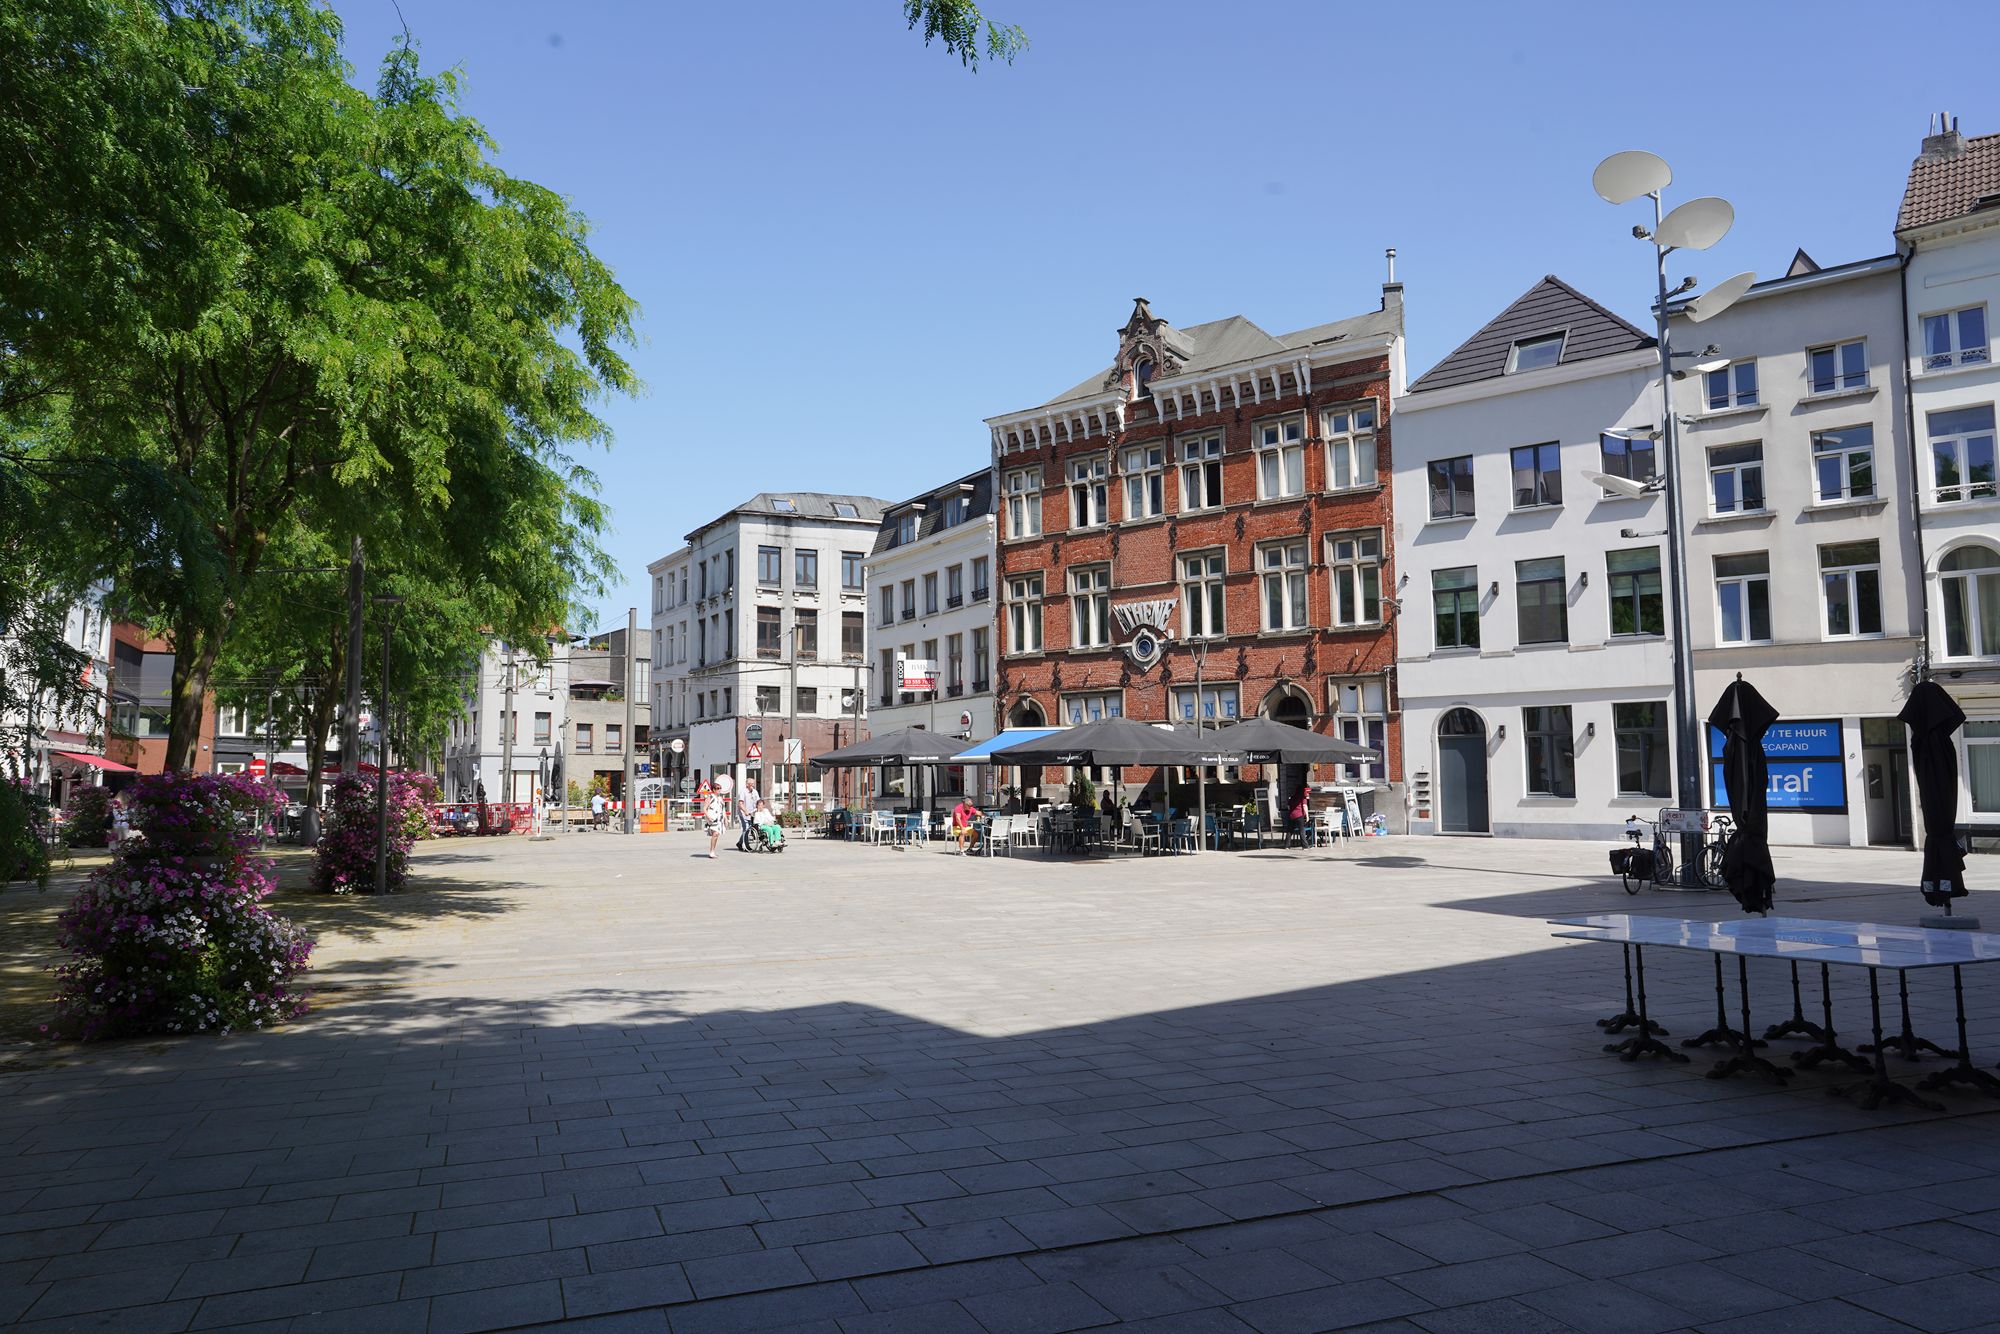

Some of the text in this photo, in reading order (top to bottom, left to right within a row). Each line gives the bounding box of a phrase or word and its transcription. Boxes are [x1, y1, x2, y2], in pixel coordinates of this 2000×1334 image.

[1112, 598, 1178, 635] ATHENE
[1779, 730, 1792, 738] TE
[1795, 729, 1827, 737] HUUR
[1761, 743, 1809, 751] ECAPAND
